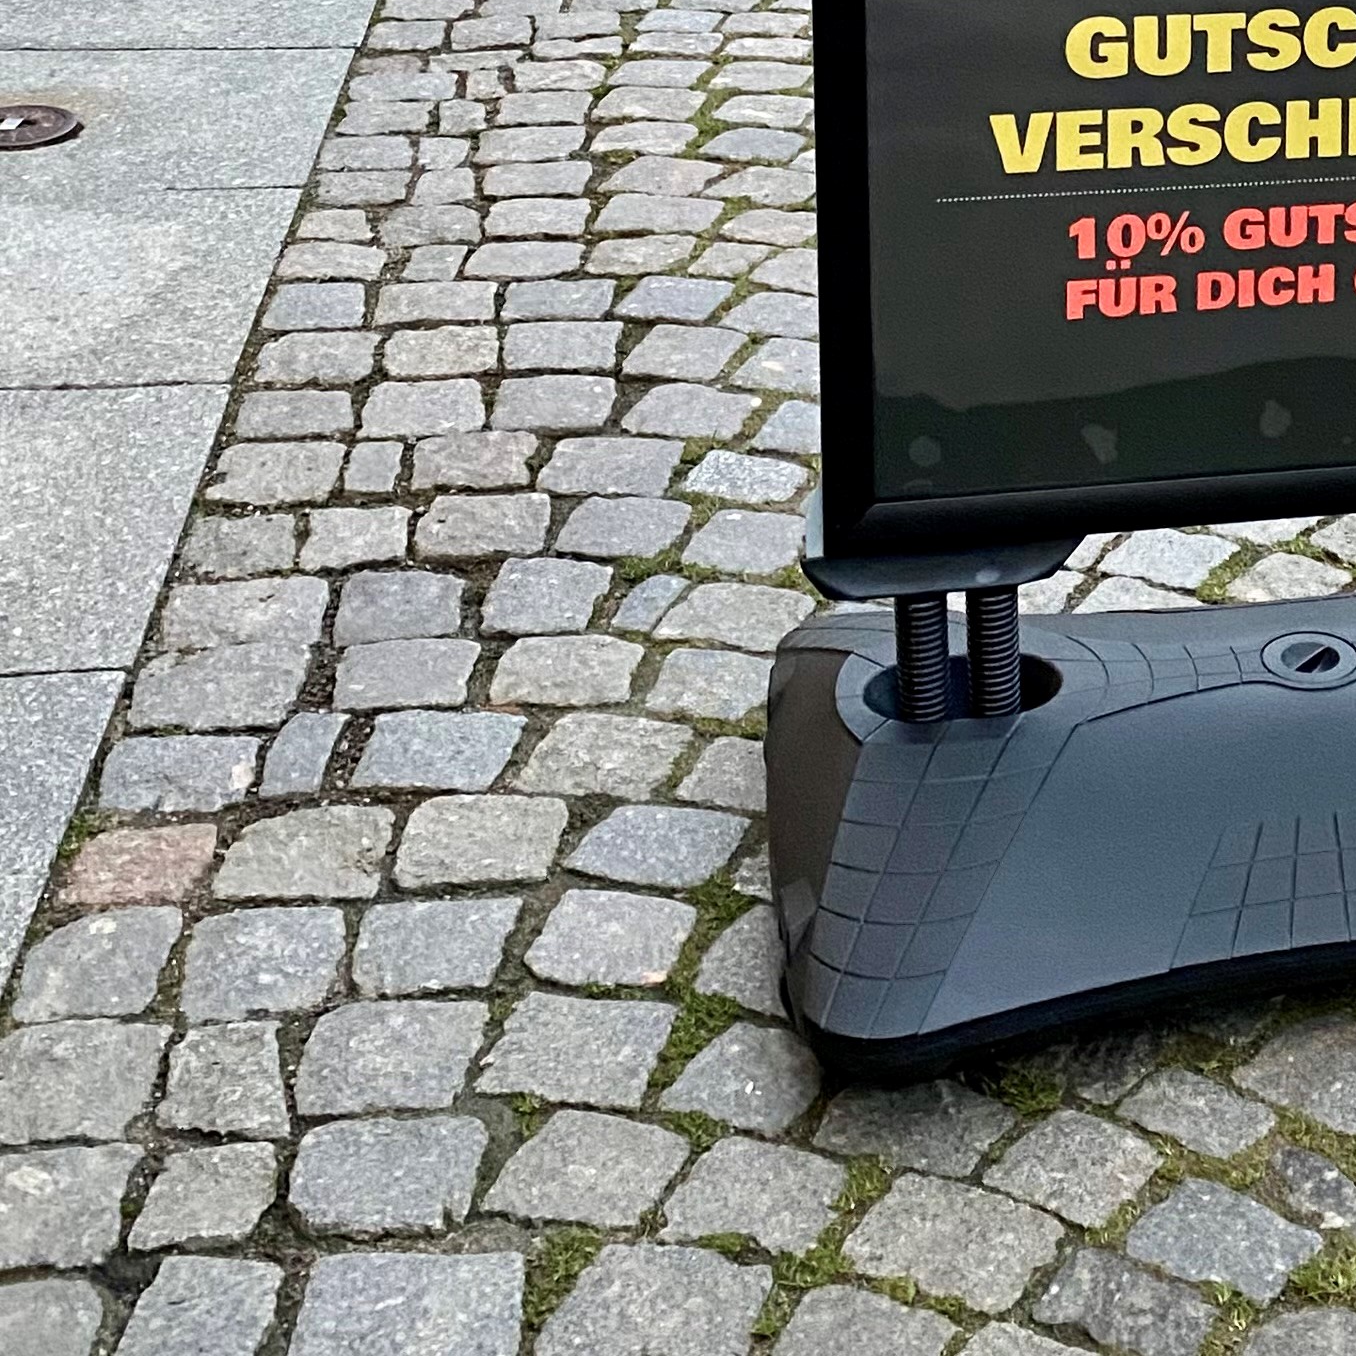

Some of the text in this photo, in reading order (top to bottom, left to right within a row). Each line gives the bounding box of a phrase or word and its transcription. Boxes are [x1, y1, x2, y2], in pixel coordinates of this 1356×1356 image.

[1068, 211, 1206, 260] 10%
[1066, 259, 1178, 320] FÜR
[1196, 263, 1336, 312] DICH
